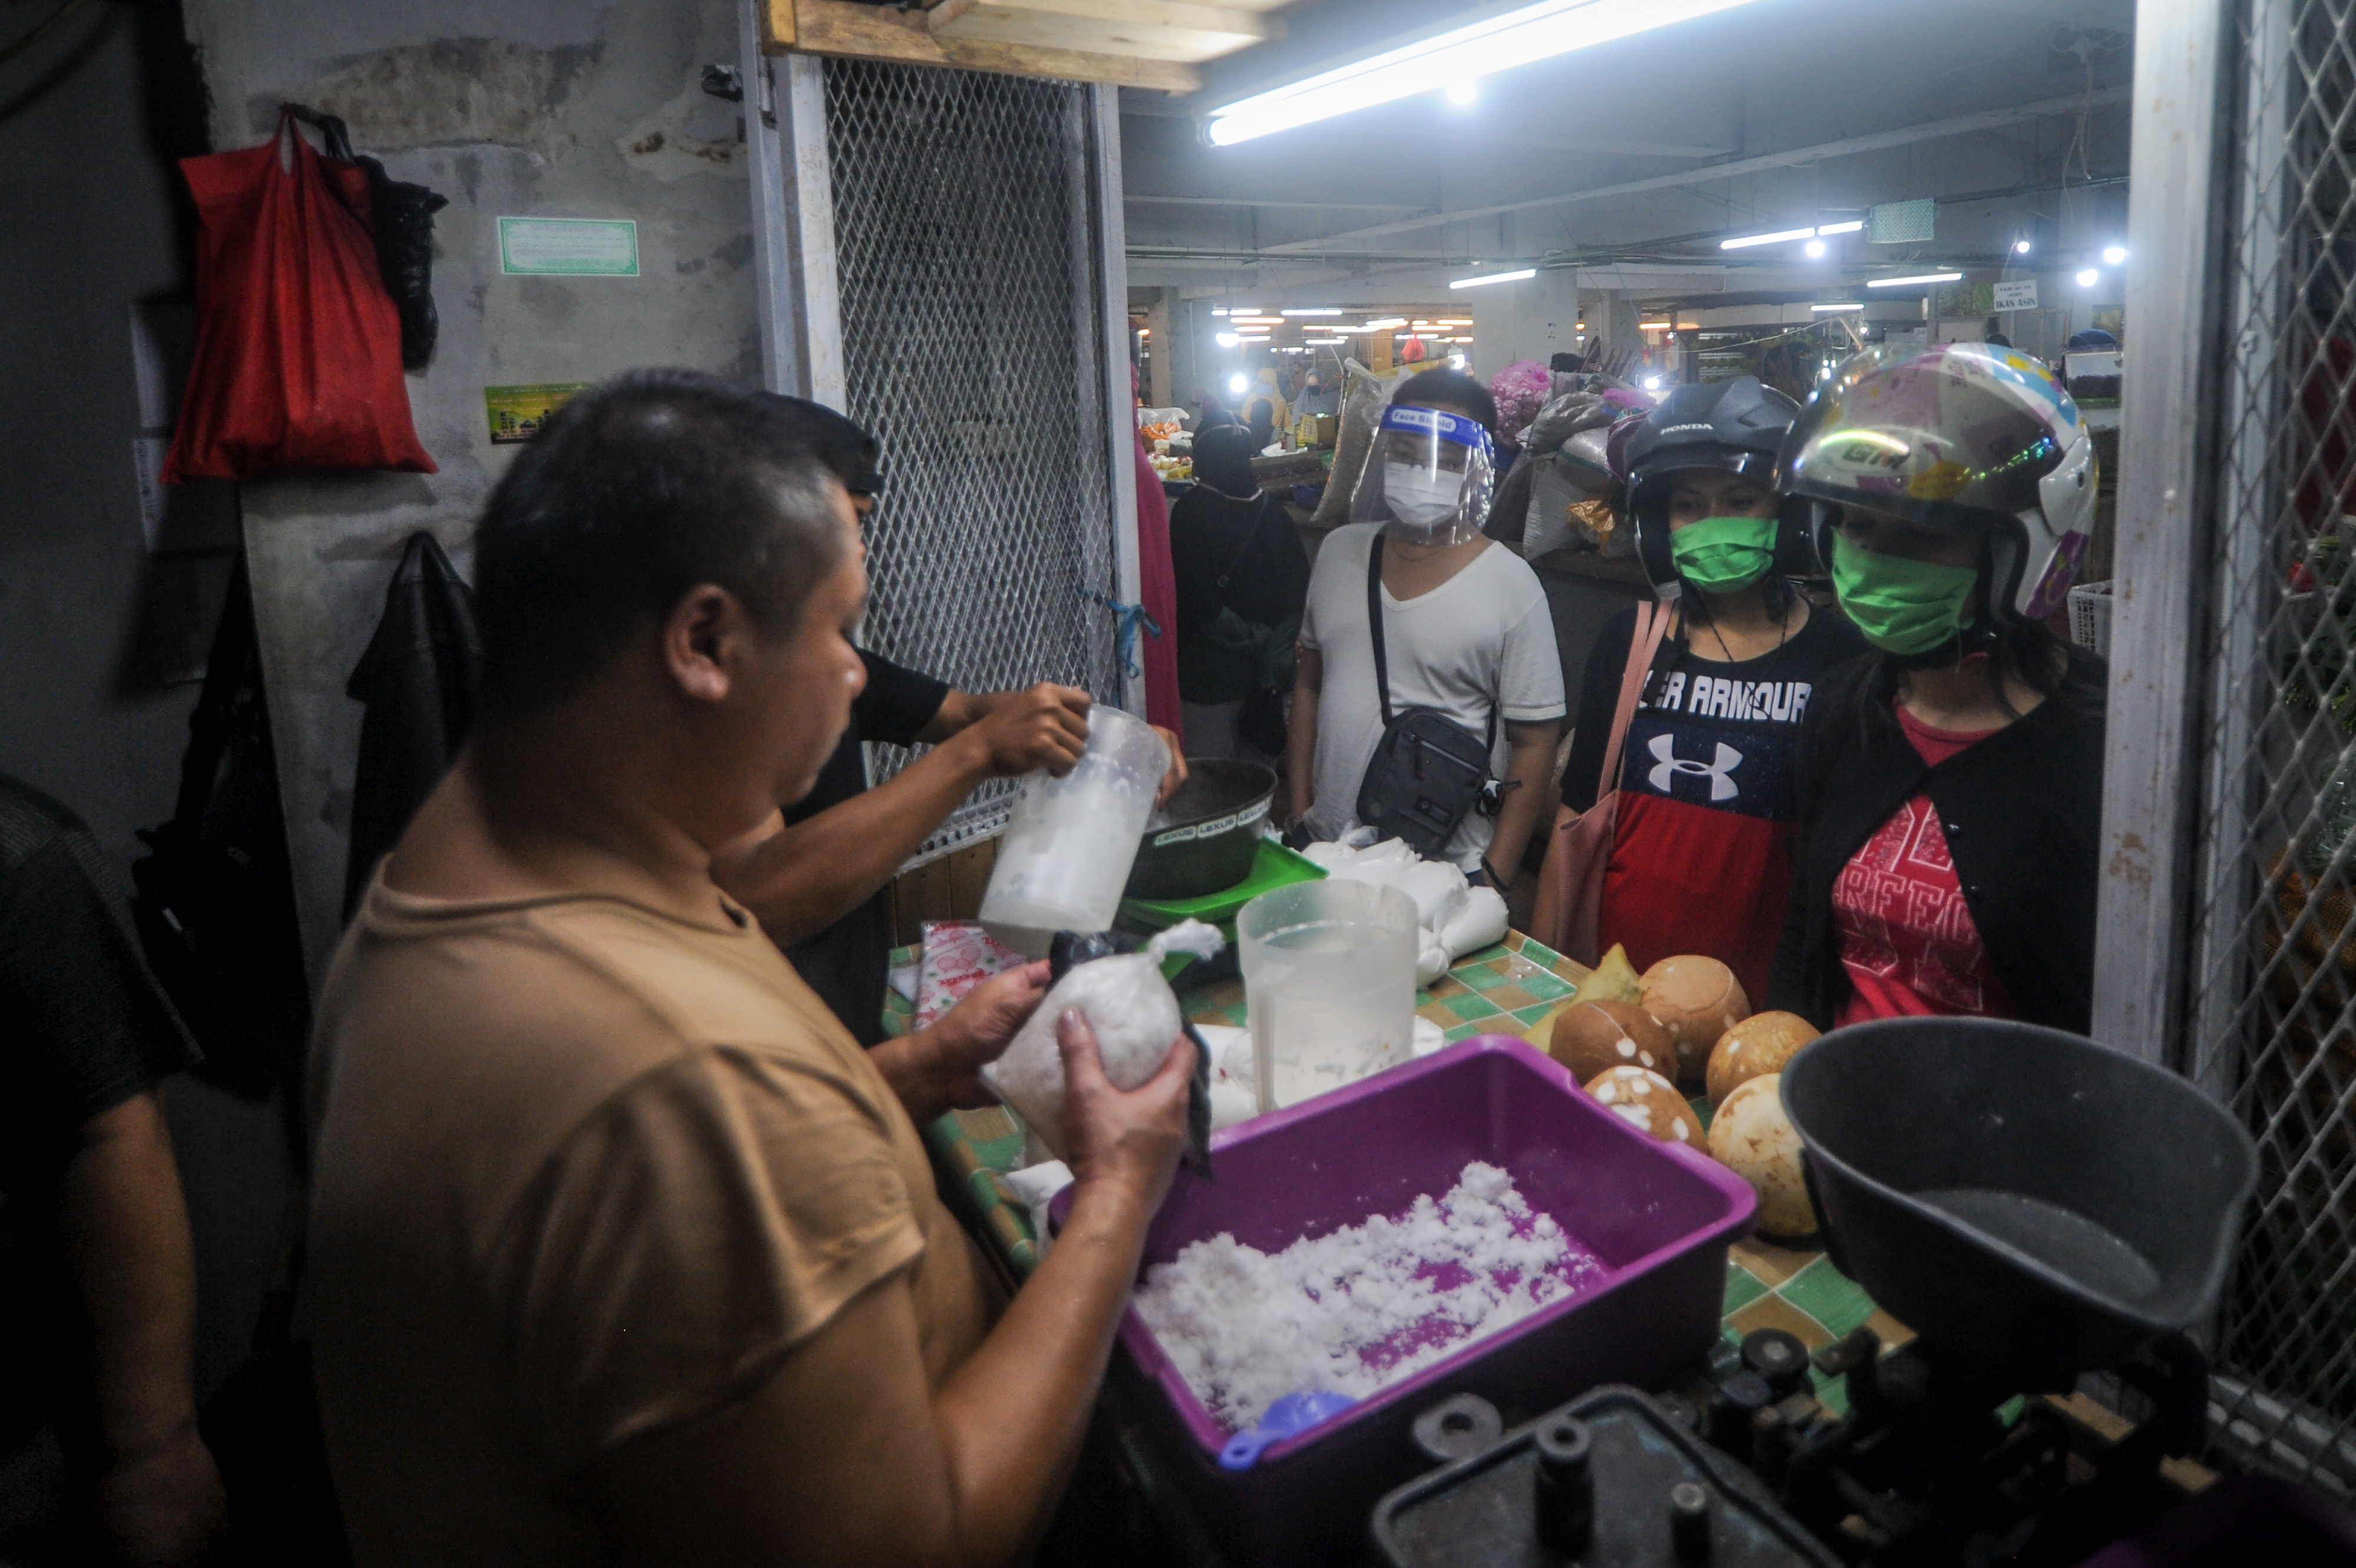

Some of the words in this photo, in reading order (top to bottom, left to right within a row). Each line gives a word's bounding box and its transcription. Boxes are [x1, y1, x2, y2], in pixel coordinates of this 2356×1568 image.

[1996, 299, 2015, 309] IKAN
[1394, 412, 1416, 422] Face
[1418, 414, 1452, 429] Sheld
[1660, 423, 1714, 435] HONDA
[1688, 675, 1812, 723] ARMOUR
[1157, 828, 1194, 843] LEXUS
[1199, 817, 1235, 833] LEXUS
